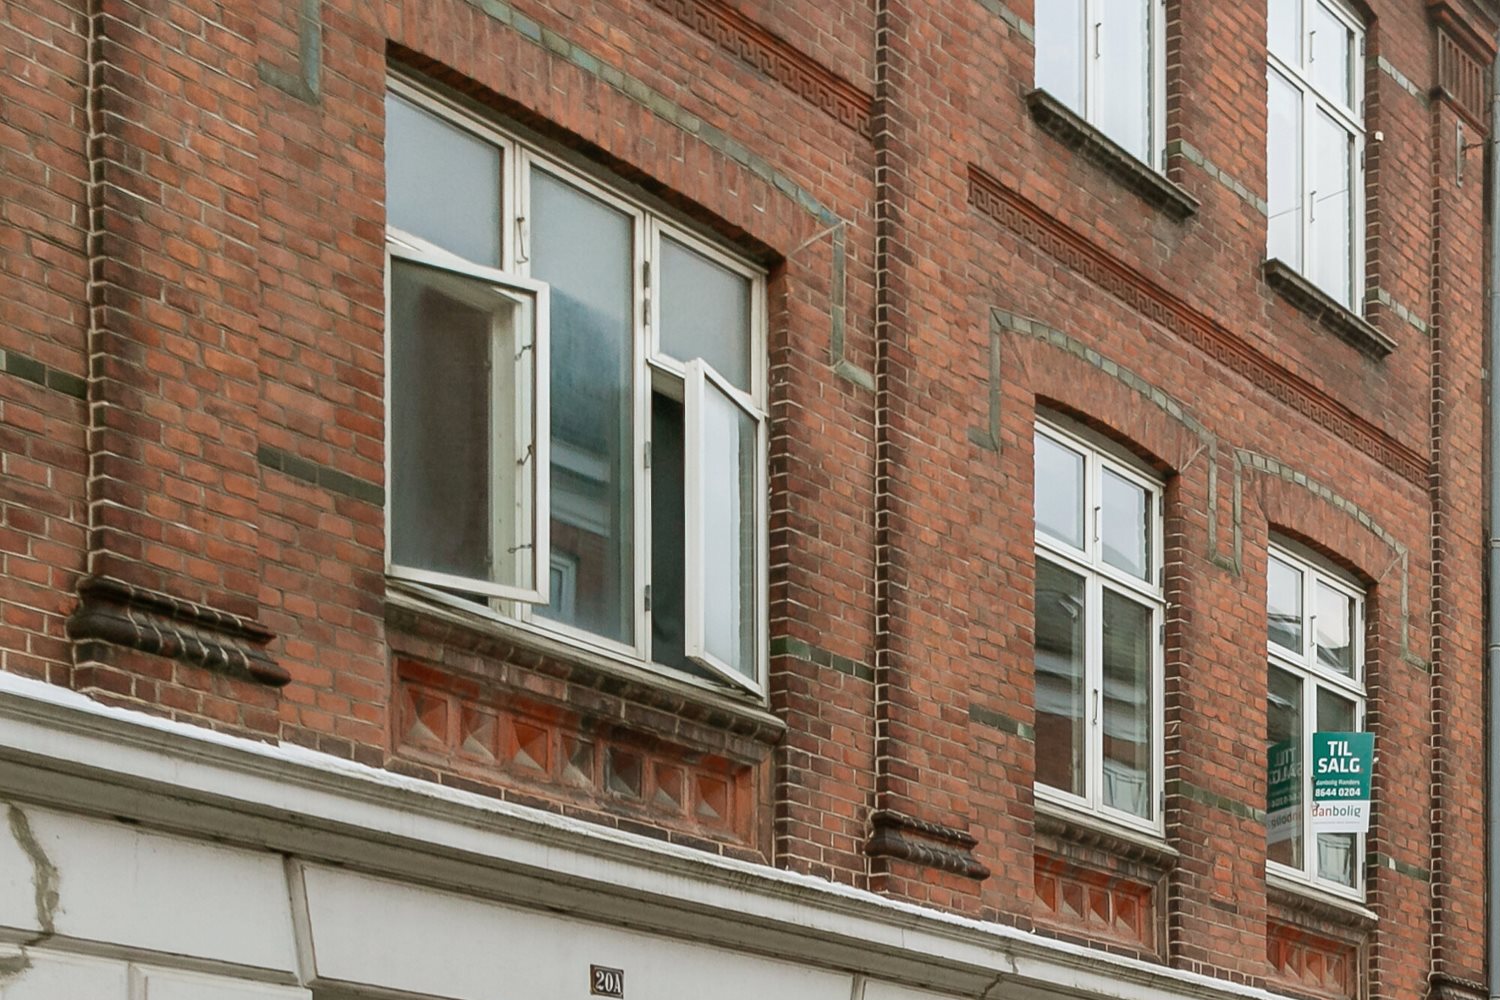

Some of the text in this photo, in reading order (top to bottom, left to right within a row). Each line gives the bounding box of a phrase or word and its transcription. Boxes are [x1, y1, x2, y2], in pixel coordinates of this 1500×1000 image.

[1327, 741, 1352, 756] TIL
[1317, 757, 1361, 773] SALG
[1315, 787, 1361, 797] 8644 0204
[1312, 804, 1361, 818] danbolig
[596, 970, 621, 993] 20A
